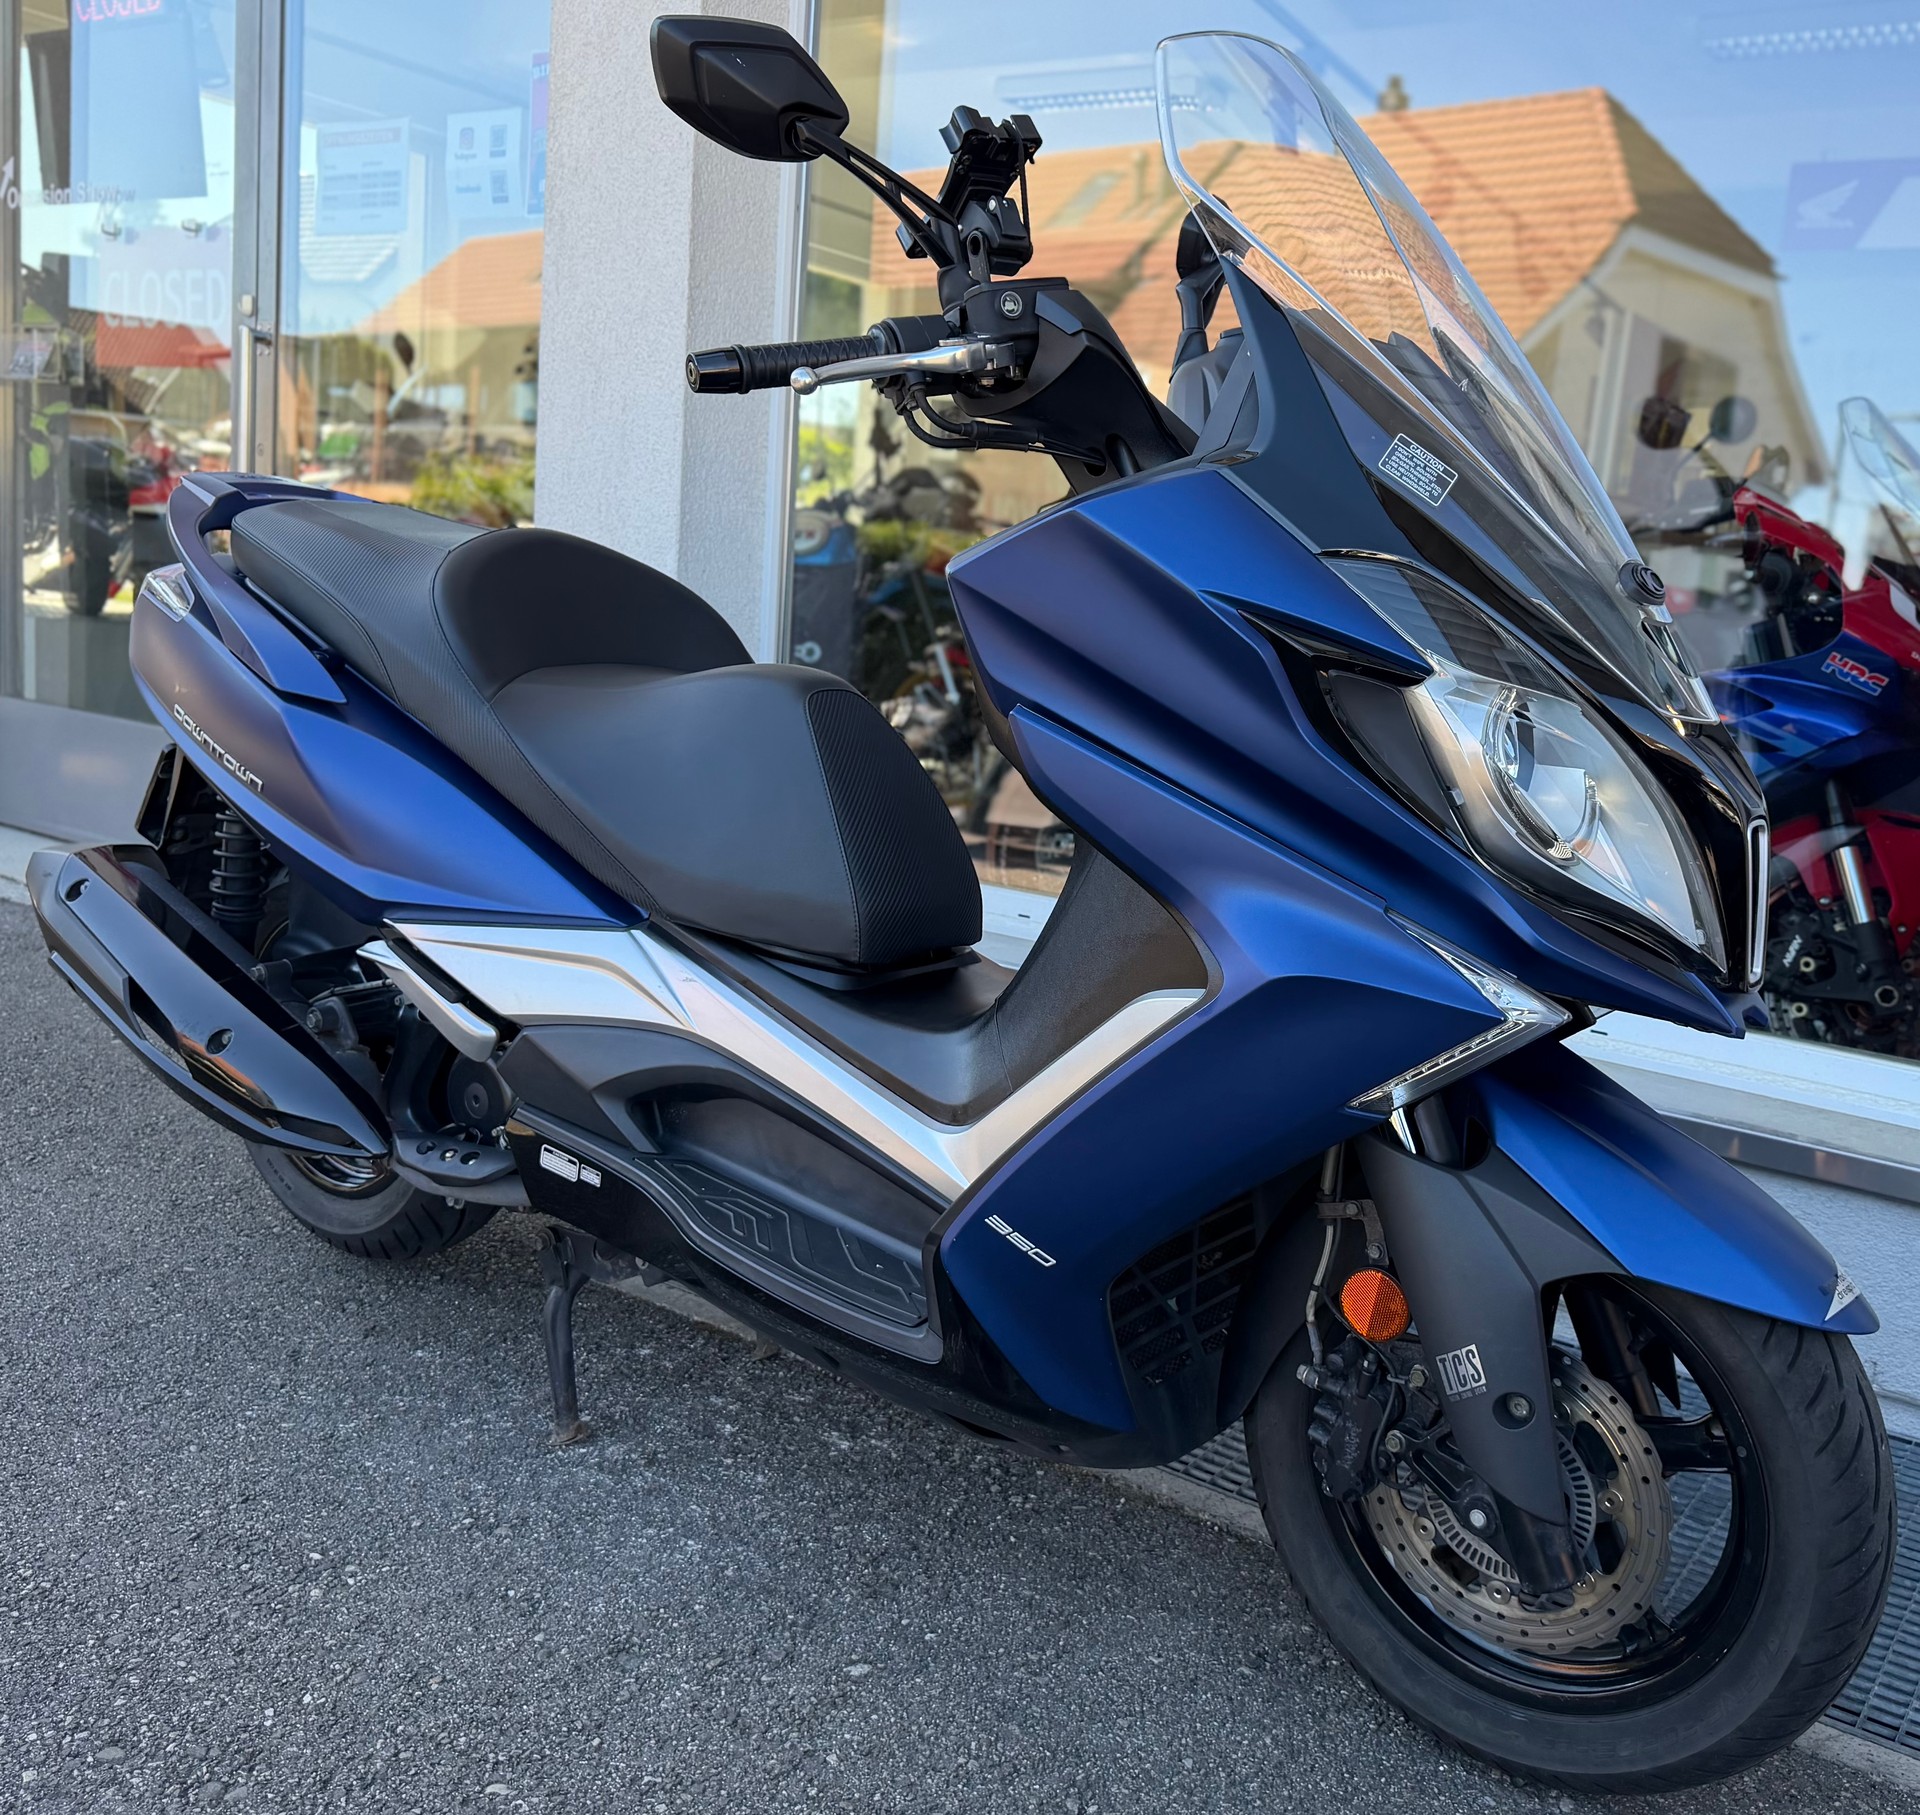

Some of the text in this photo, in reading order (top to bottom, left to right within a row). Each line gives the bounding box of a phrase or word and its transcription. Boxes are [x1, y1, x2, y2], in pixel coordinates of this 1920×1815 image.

[104, 269, 226, 328] CLOSED
[1388, 459, 1439, 497] USE NEUTRAL SOAP TO
[1394, 451, 1437, 482] ORGANIC SOLVENT
[1410, 444, 1444, 472] CAUTION
[1425, 466, 1438, 477] WITH
[1820, 651, 1890, 696] HRC
[984, 1214, 1057, 1267] 350
[1438, 1347, 1482, 1391] TCS
